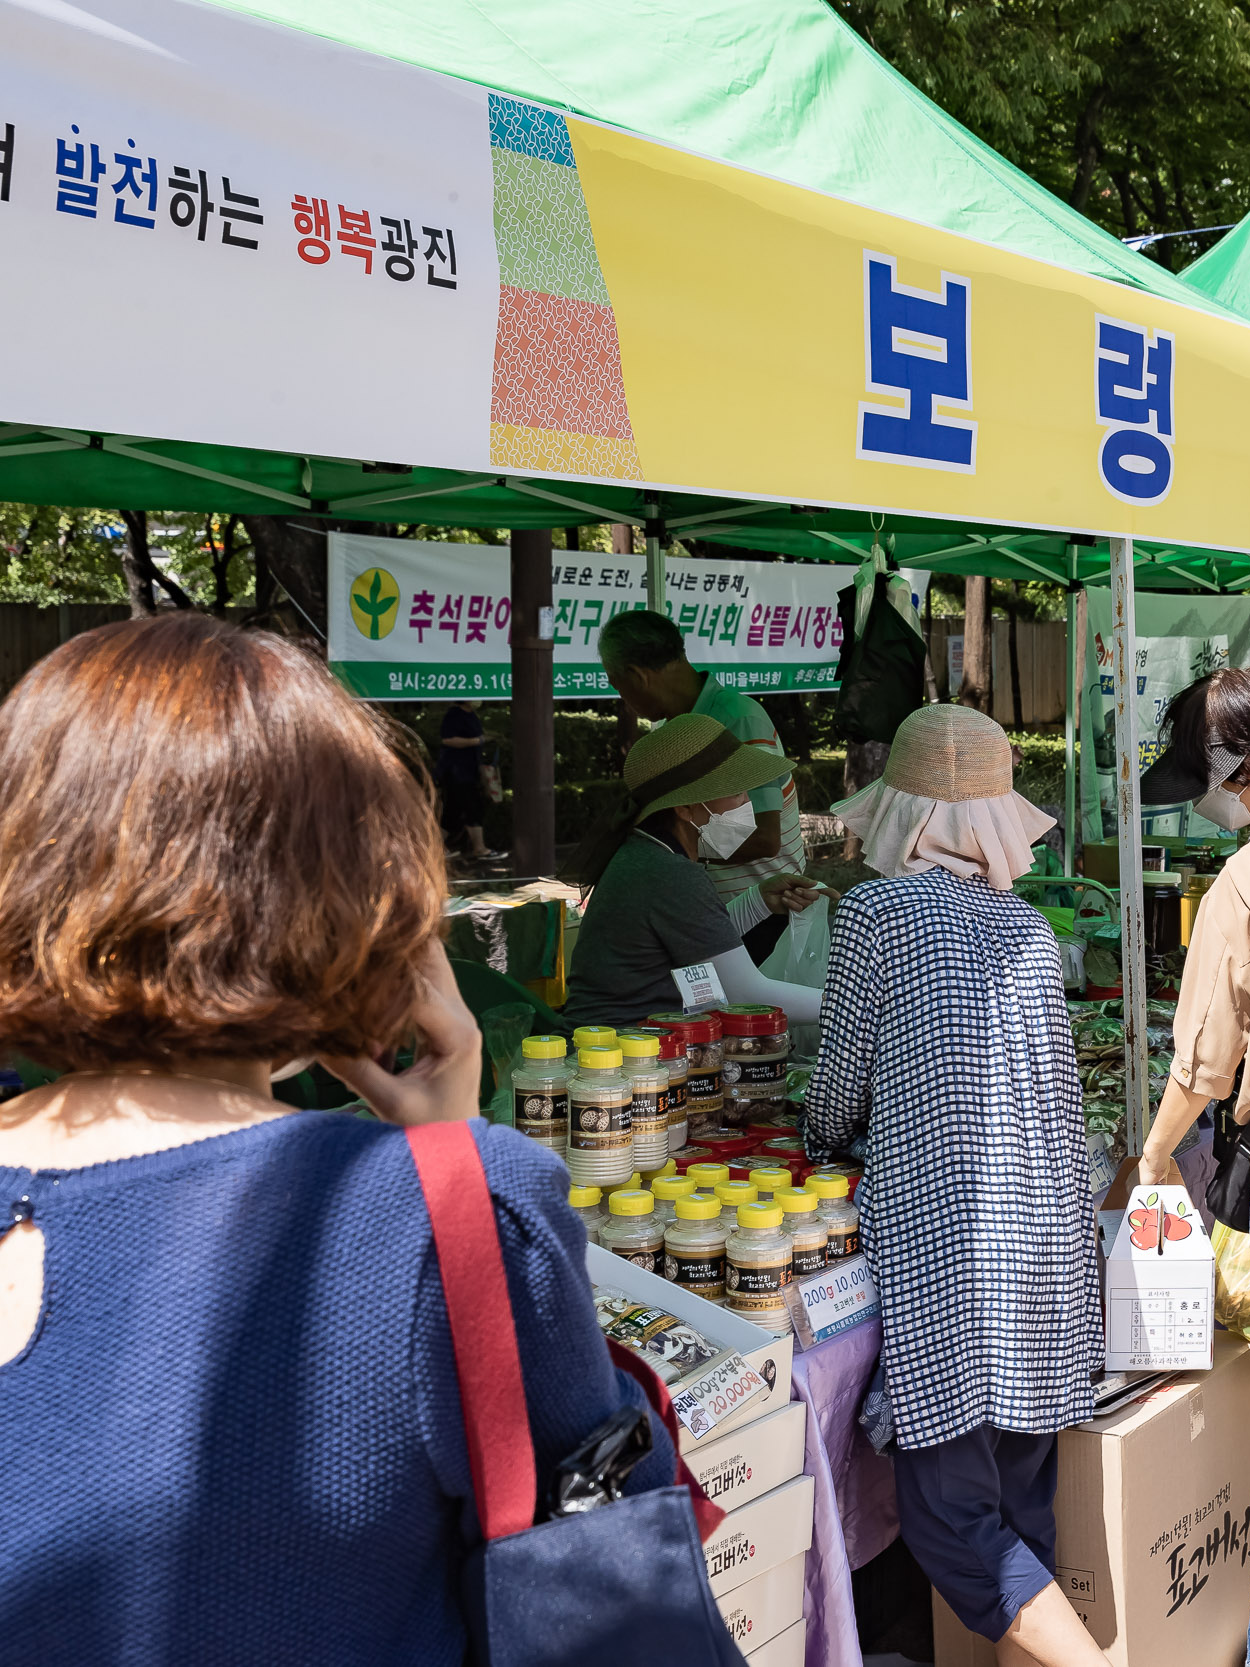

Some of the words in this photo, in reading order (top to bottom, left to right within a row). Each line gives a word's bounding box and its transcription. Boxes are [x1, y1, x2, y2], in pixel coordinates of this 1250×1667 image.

[56, 126, 263, 250] 발전하는
[290, 194, 458, 290] 행복광진
[804, 1285, 834, 1307] 200g
[706, 1539, 749, 1578] 고버섯
[1071, 1577, 1090, 1592] Set
